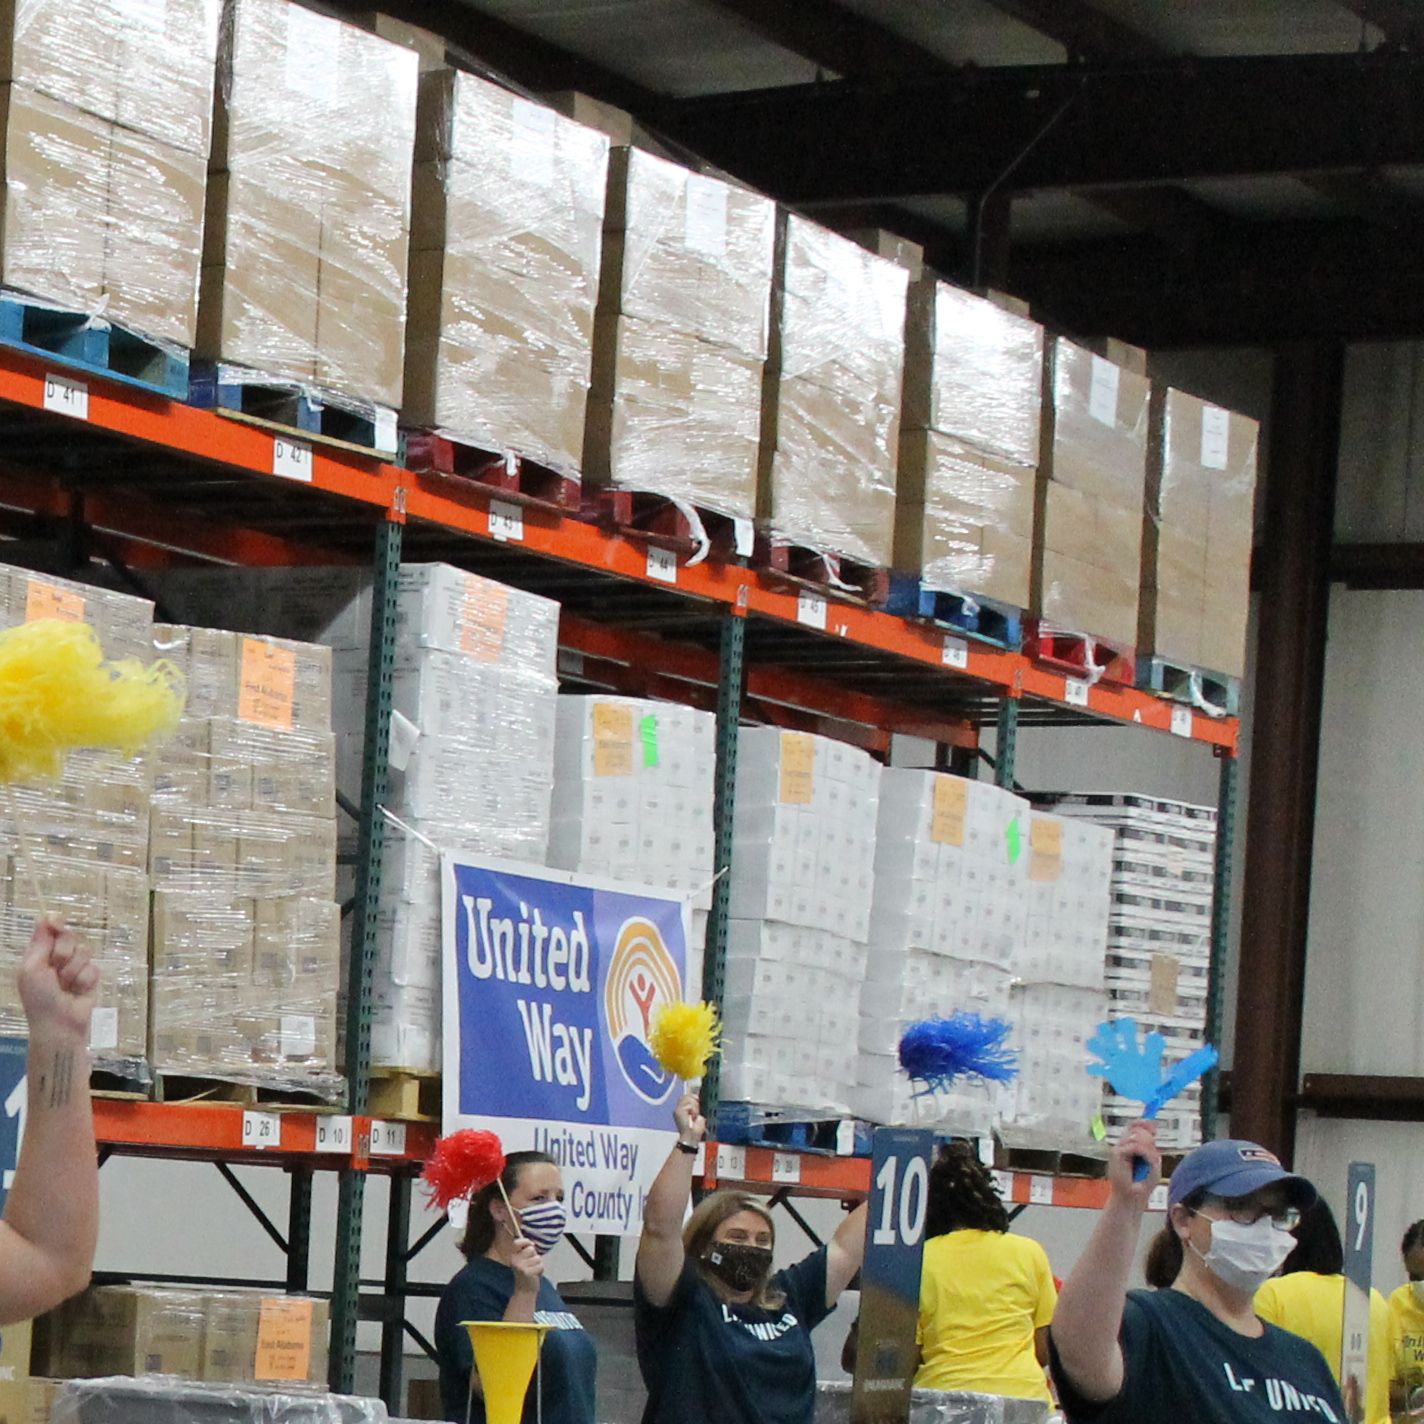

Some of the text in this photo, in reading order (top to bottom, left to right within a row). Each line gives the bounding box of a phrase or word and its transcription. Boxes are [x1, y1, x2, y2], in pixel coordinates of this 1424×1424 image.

[47, 381, 77, 405] D 41
[276, 442, 283, 459] D
[462, 895, 590, 992] United
[517, 999, 592, 1112] Way
[245, 1120, 270, 1137] D 26
[319, 1127, 343, 1144] D 10
[373, 1128, 396, 1145] D 11
[534, 1128, 638, 1180] United Way
[572, 1182, 633, 1227] County
[874, 1154, 928, 1246] 10
[1355, 1182, 1368, 1250] 9
